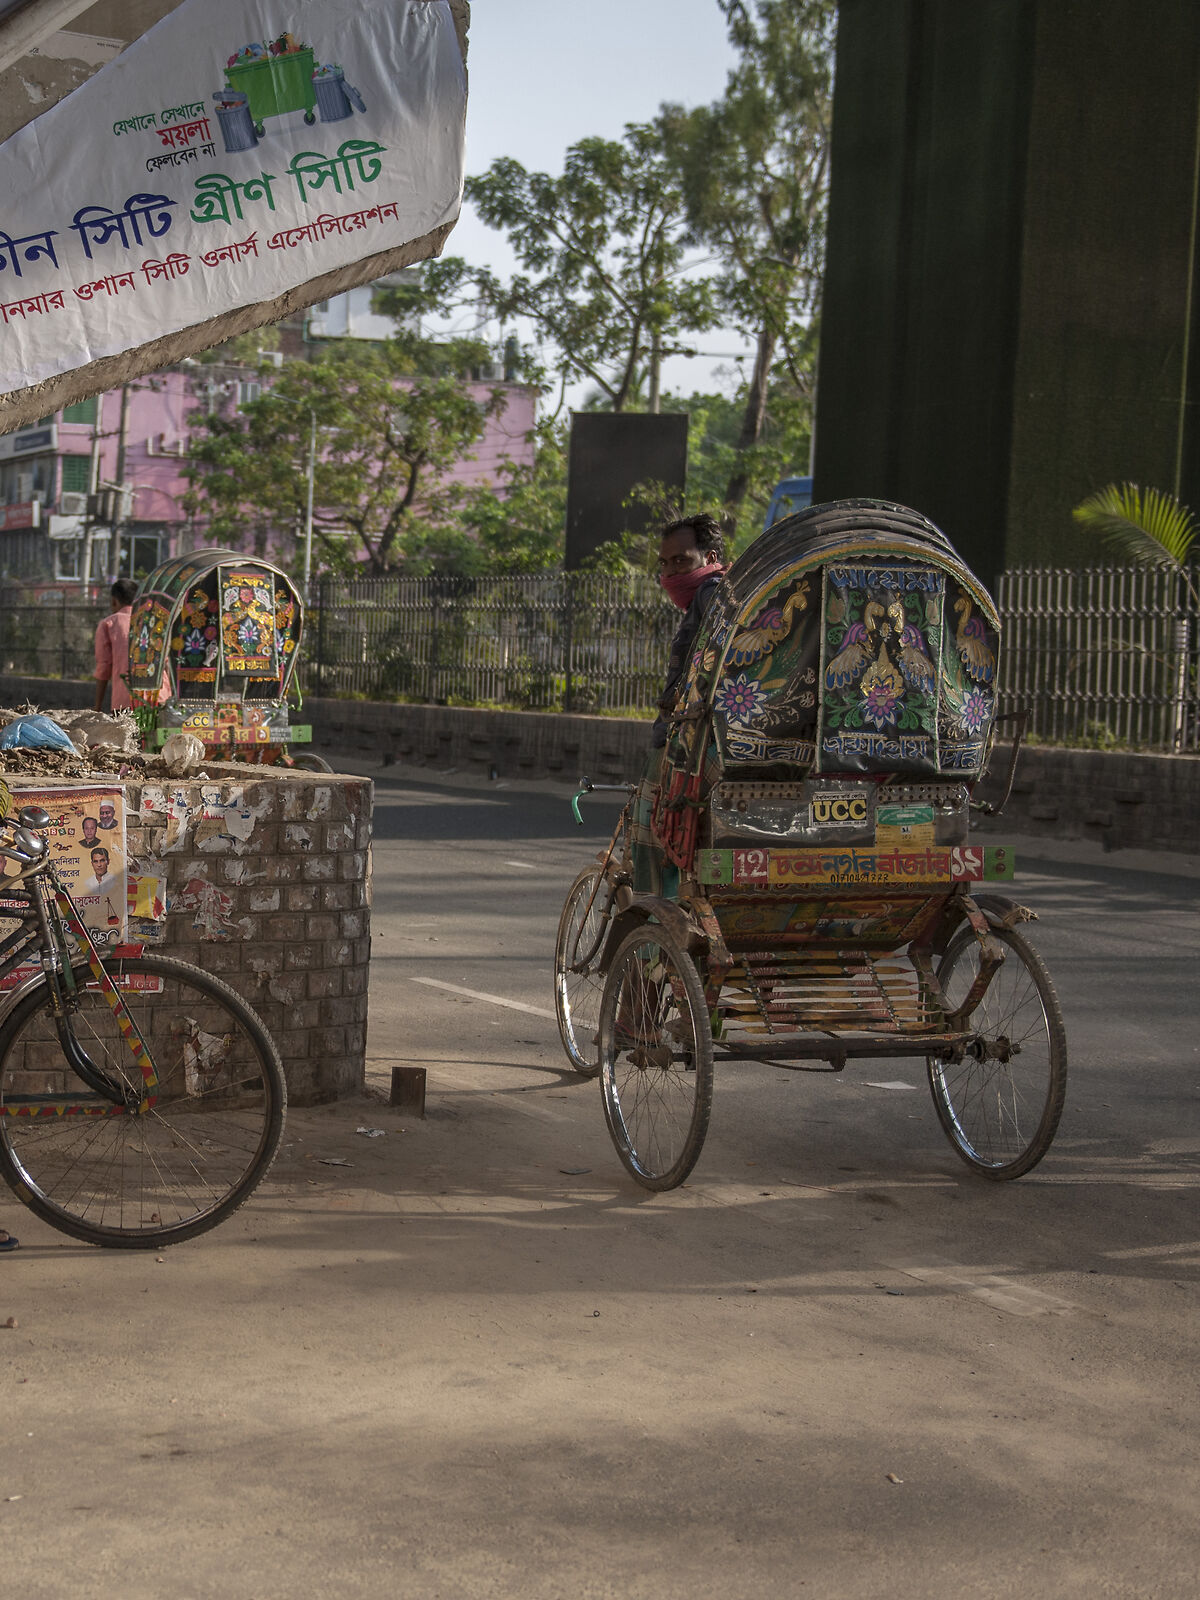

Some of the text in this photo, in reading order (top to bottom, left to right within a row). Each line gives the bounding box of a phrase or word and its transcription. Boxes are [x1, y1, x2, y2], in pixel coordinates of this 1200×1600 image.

[112, 100, 207, 137] যেখানে সেখানে
[155, 116, 212, 149] ময়লা
[145, 142, 217, 173] ফেলবেন না
[67, 193, 179, 260] সিটি
[189, 173, 278, 226] গ্রীণ
[284, 139, 388, 203] সিটি
[72, 271, 136, 301] ওশান
[139, 252, 192, 287] সিটি
[199, 230, 260, 269] ওনার্স
[266, 201, 400, 251] এসোসিয়েশন
[813, 799, 867, 822] UCC
[736, 850, 768, 878] 12
[951, 847, 982, 877] ১২
